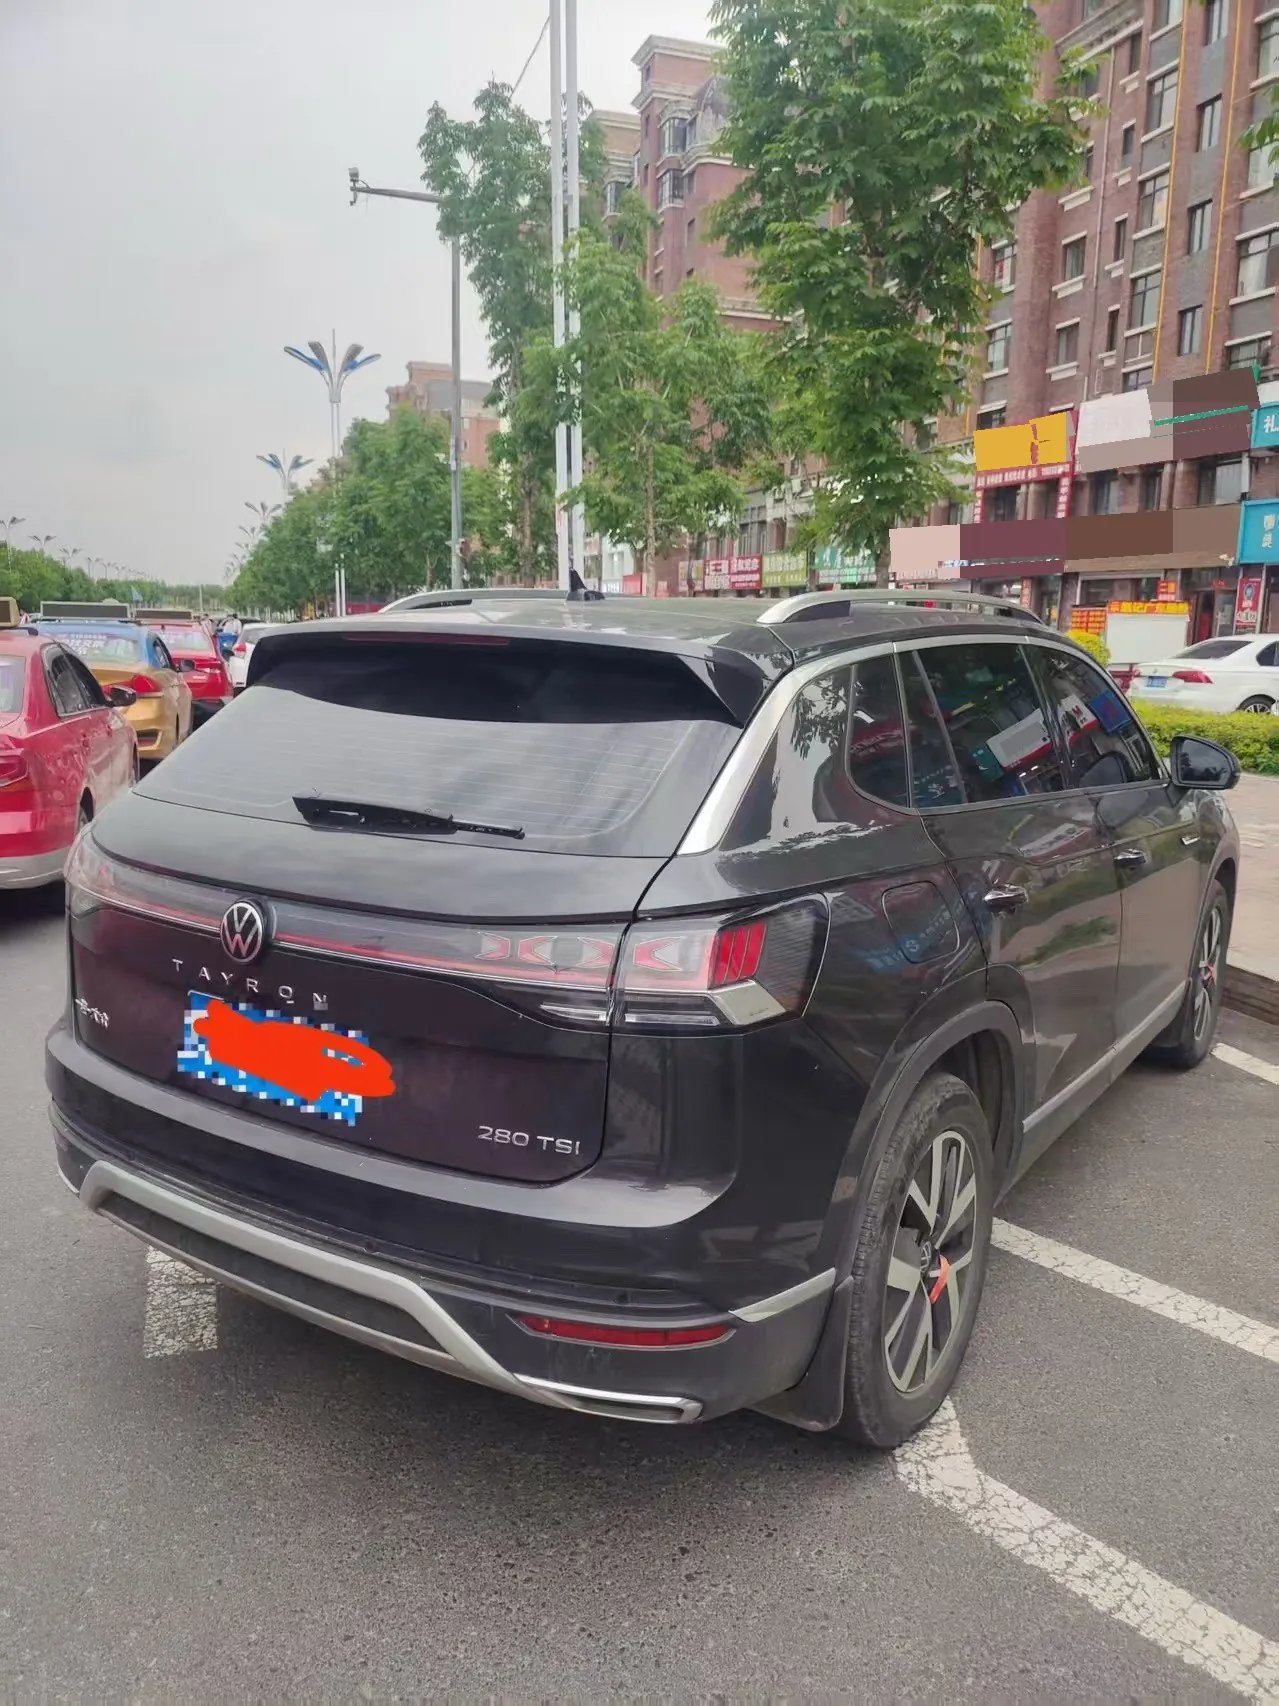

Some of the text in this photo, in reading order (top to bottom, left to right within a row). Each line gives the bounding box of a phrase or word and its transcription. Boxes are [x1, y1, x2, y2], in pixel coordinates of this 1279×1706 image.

[172, 957, 329, 1008] TAYRON
[477, 1125, 581, 1156] 280 TSI
